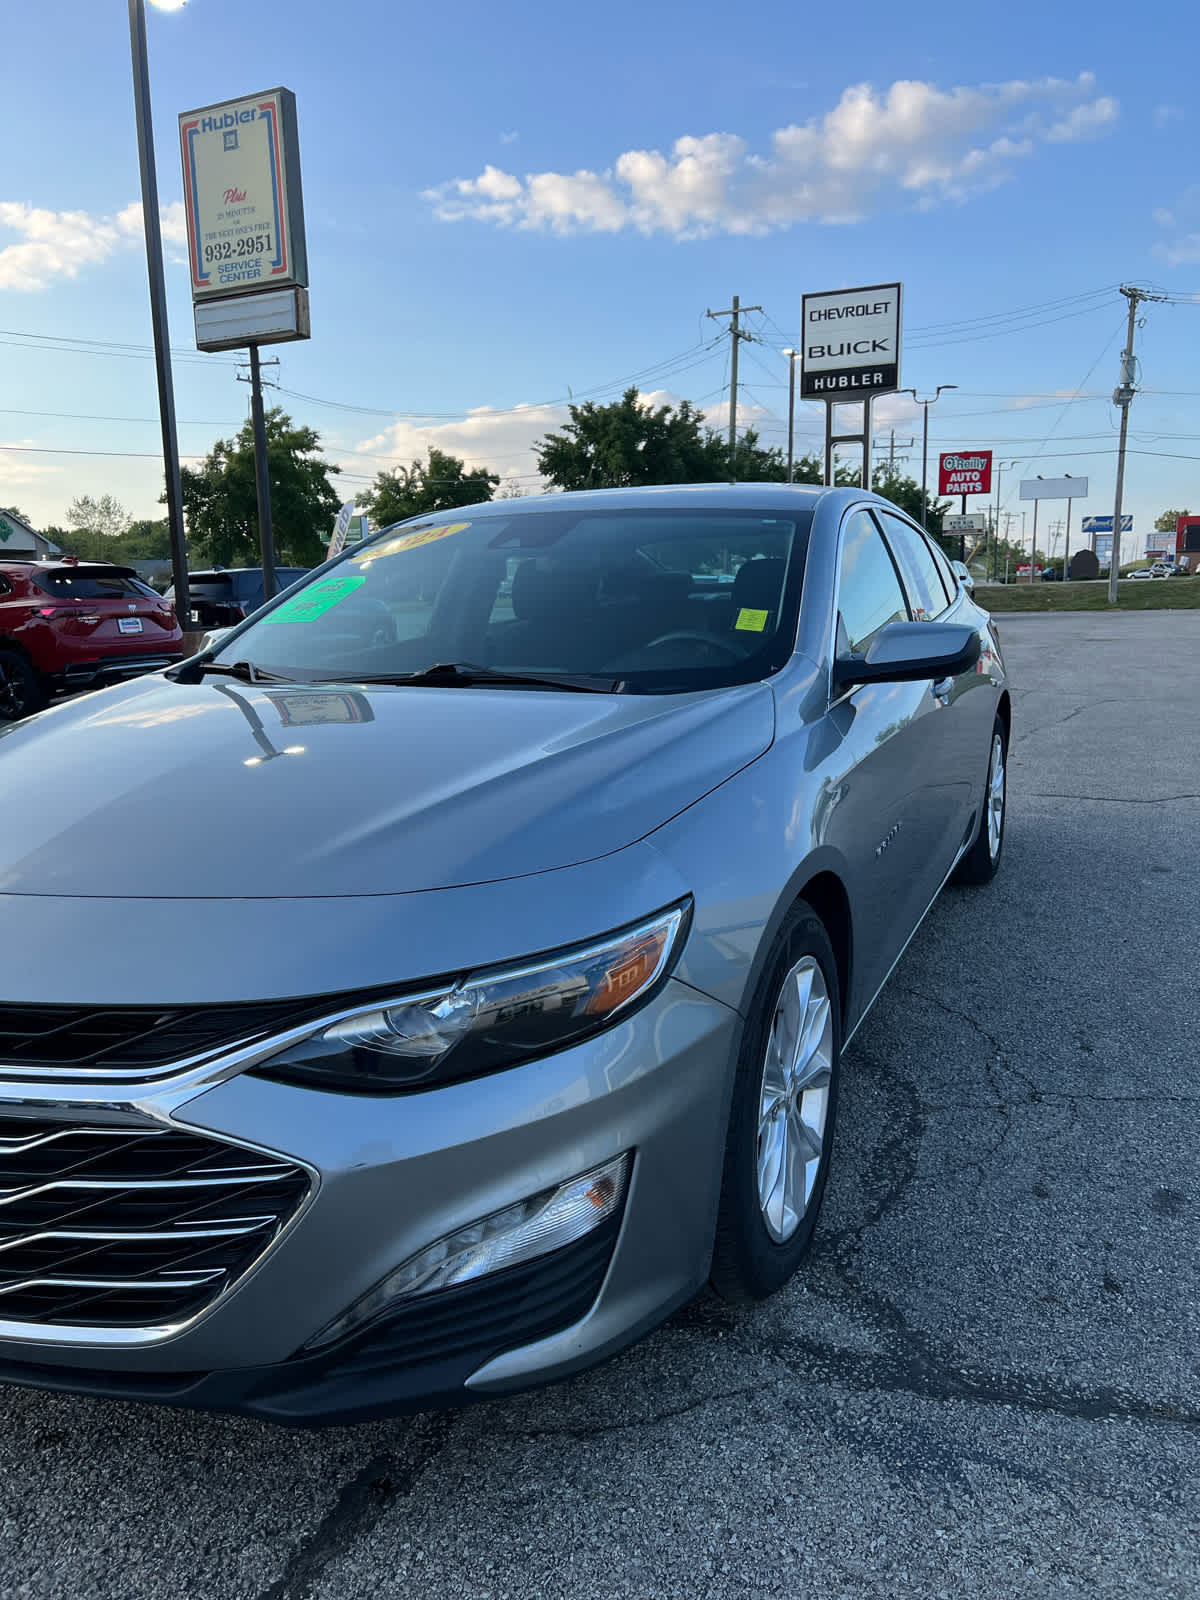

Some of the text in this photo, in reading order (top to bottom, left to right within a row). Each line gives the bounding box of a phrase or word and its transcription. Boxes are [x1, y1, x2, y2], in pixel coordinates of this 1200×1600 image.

[201, 108, 257, 133] Hubler
[222, 187, 247, 205] Plus
[204, 234, 273, 263] 932-2951
[217, 258, 262, 274] SERVICE
[219, 269, 262, 284] CENTER
[809, 302, 892, 322] CHEVROLET
[808, 338, 890, 359] BUICK
[814, 372, 883, 390] HUBLER
[943, 456, 987, 470] O'Reilly
[949, 471, 980, 482] AUTO
[946, 482, 982, 493] PARTS
